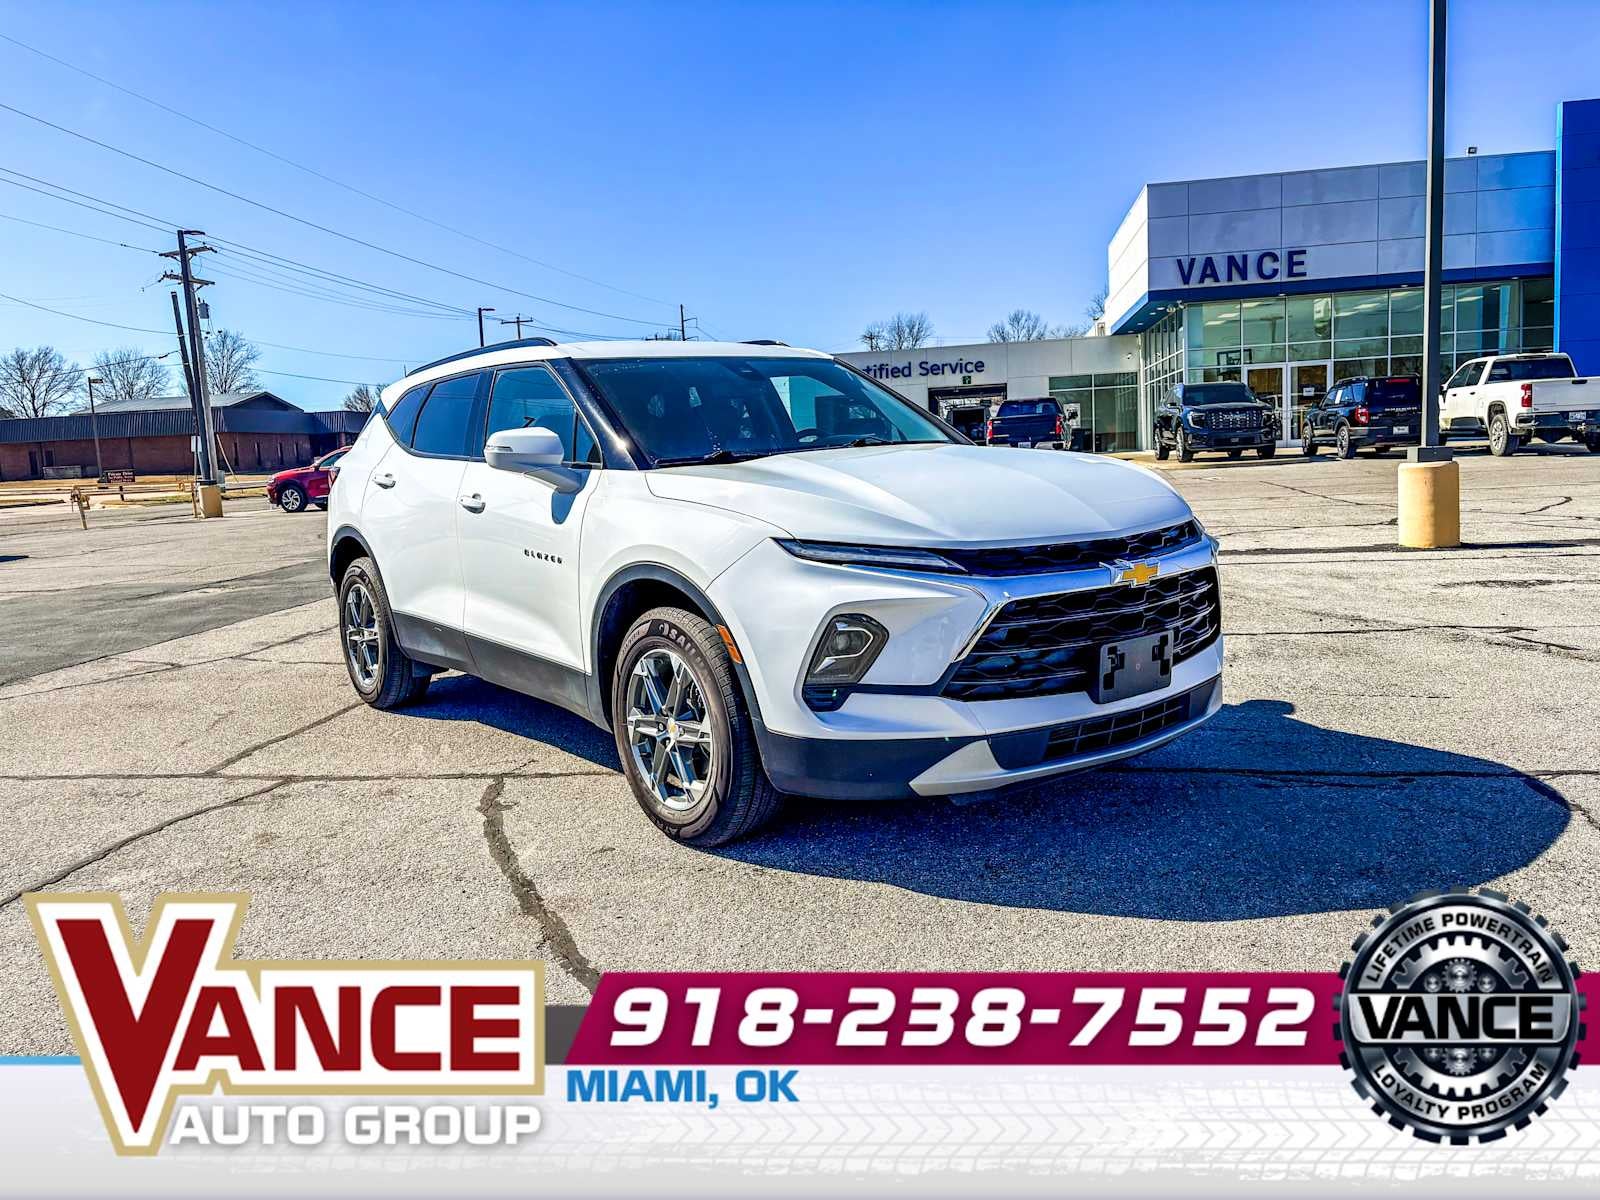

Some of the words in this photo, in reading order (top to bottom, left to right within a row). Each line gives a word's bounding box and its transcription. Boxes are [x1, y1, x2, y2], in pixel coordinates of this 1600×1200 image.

[1176, 249, 1307, 286] VANCE
[919, 358, 985, 377] Service
[523, 548, 563, 565] BLAZER
